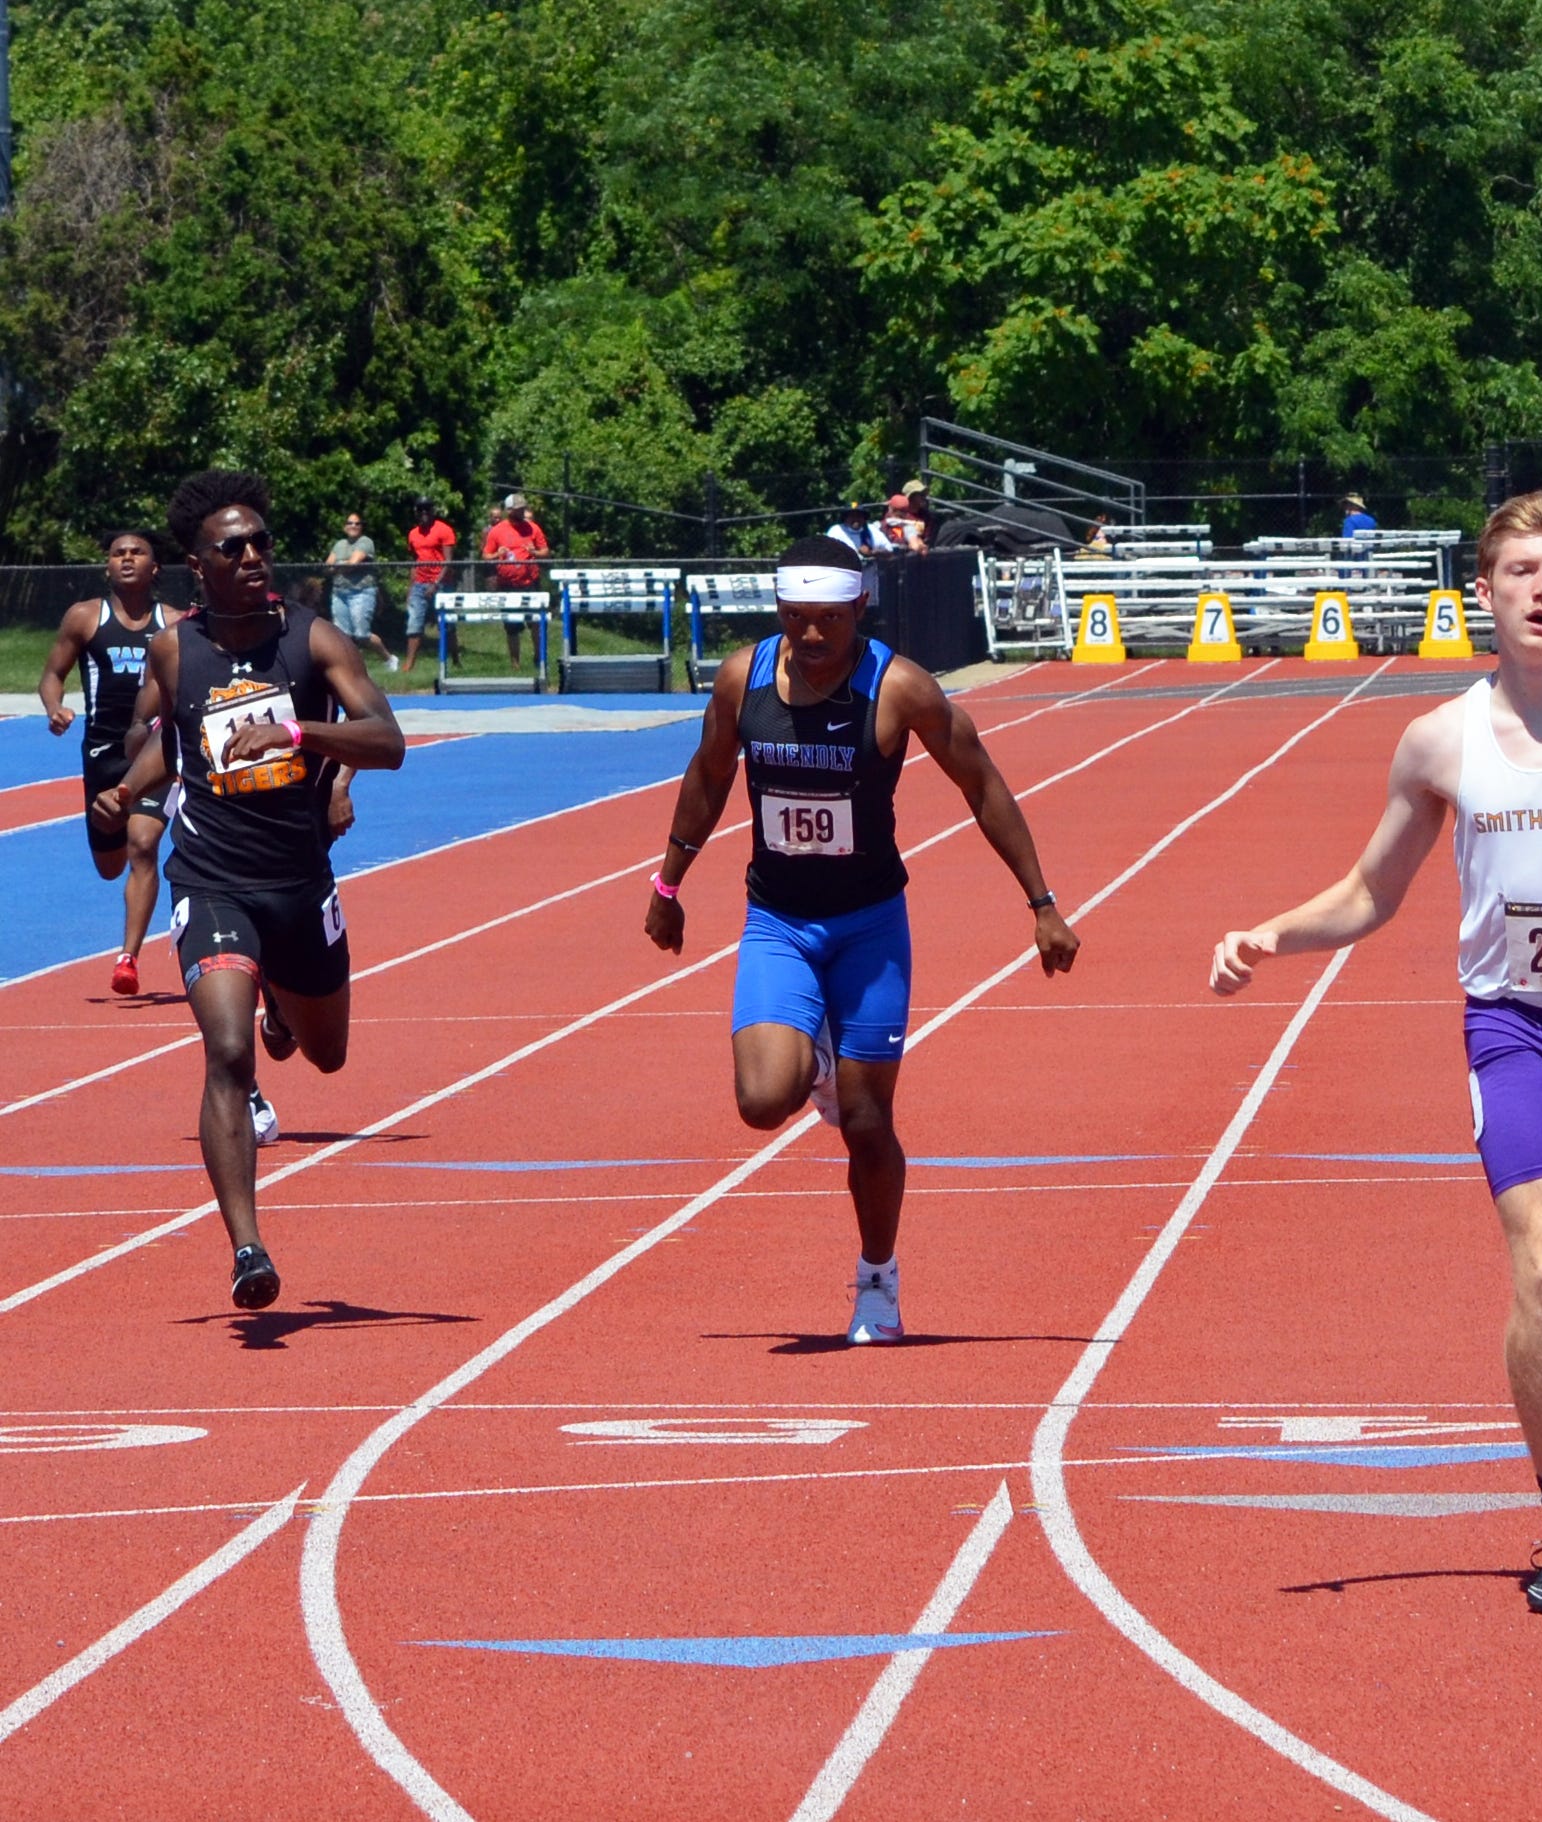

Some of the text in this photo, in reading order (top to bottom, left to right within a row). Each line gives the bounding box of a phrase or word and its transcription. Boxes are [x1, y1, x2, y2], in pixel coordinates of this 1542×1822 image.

[1090, 609, 1107, 637] 8
[1205, 609, 1223, 635] 7
[1322, 607, 1340, 635] 6
[1437, 605, 1454, 633] 5
[751, 740, 856, 772] FRIENDLY
[207, 752, 307, 796] TIGERS
[779, 806, 835, 844] 159
[331, 893, 341, 932] 6
